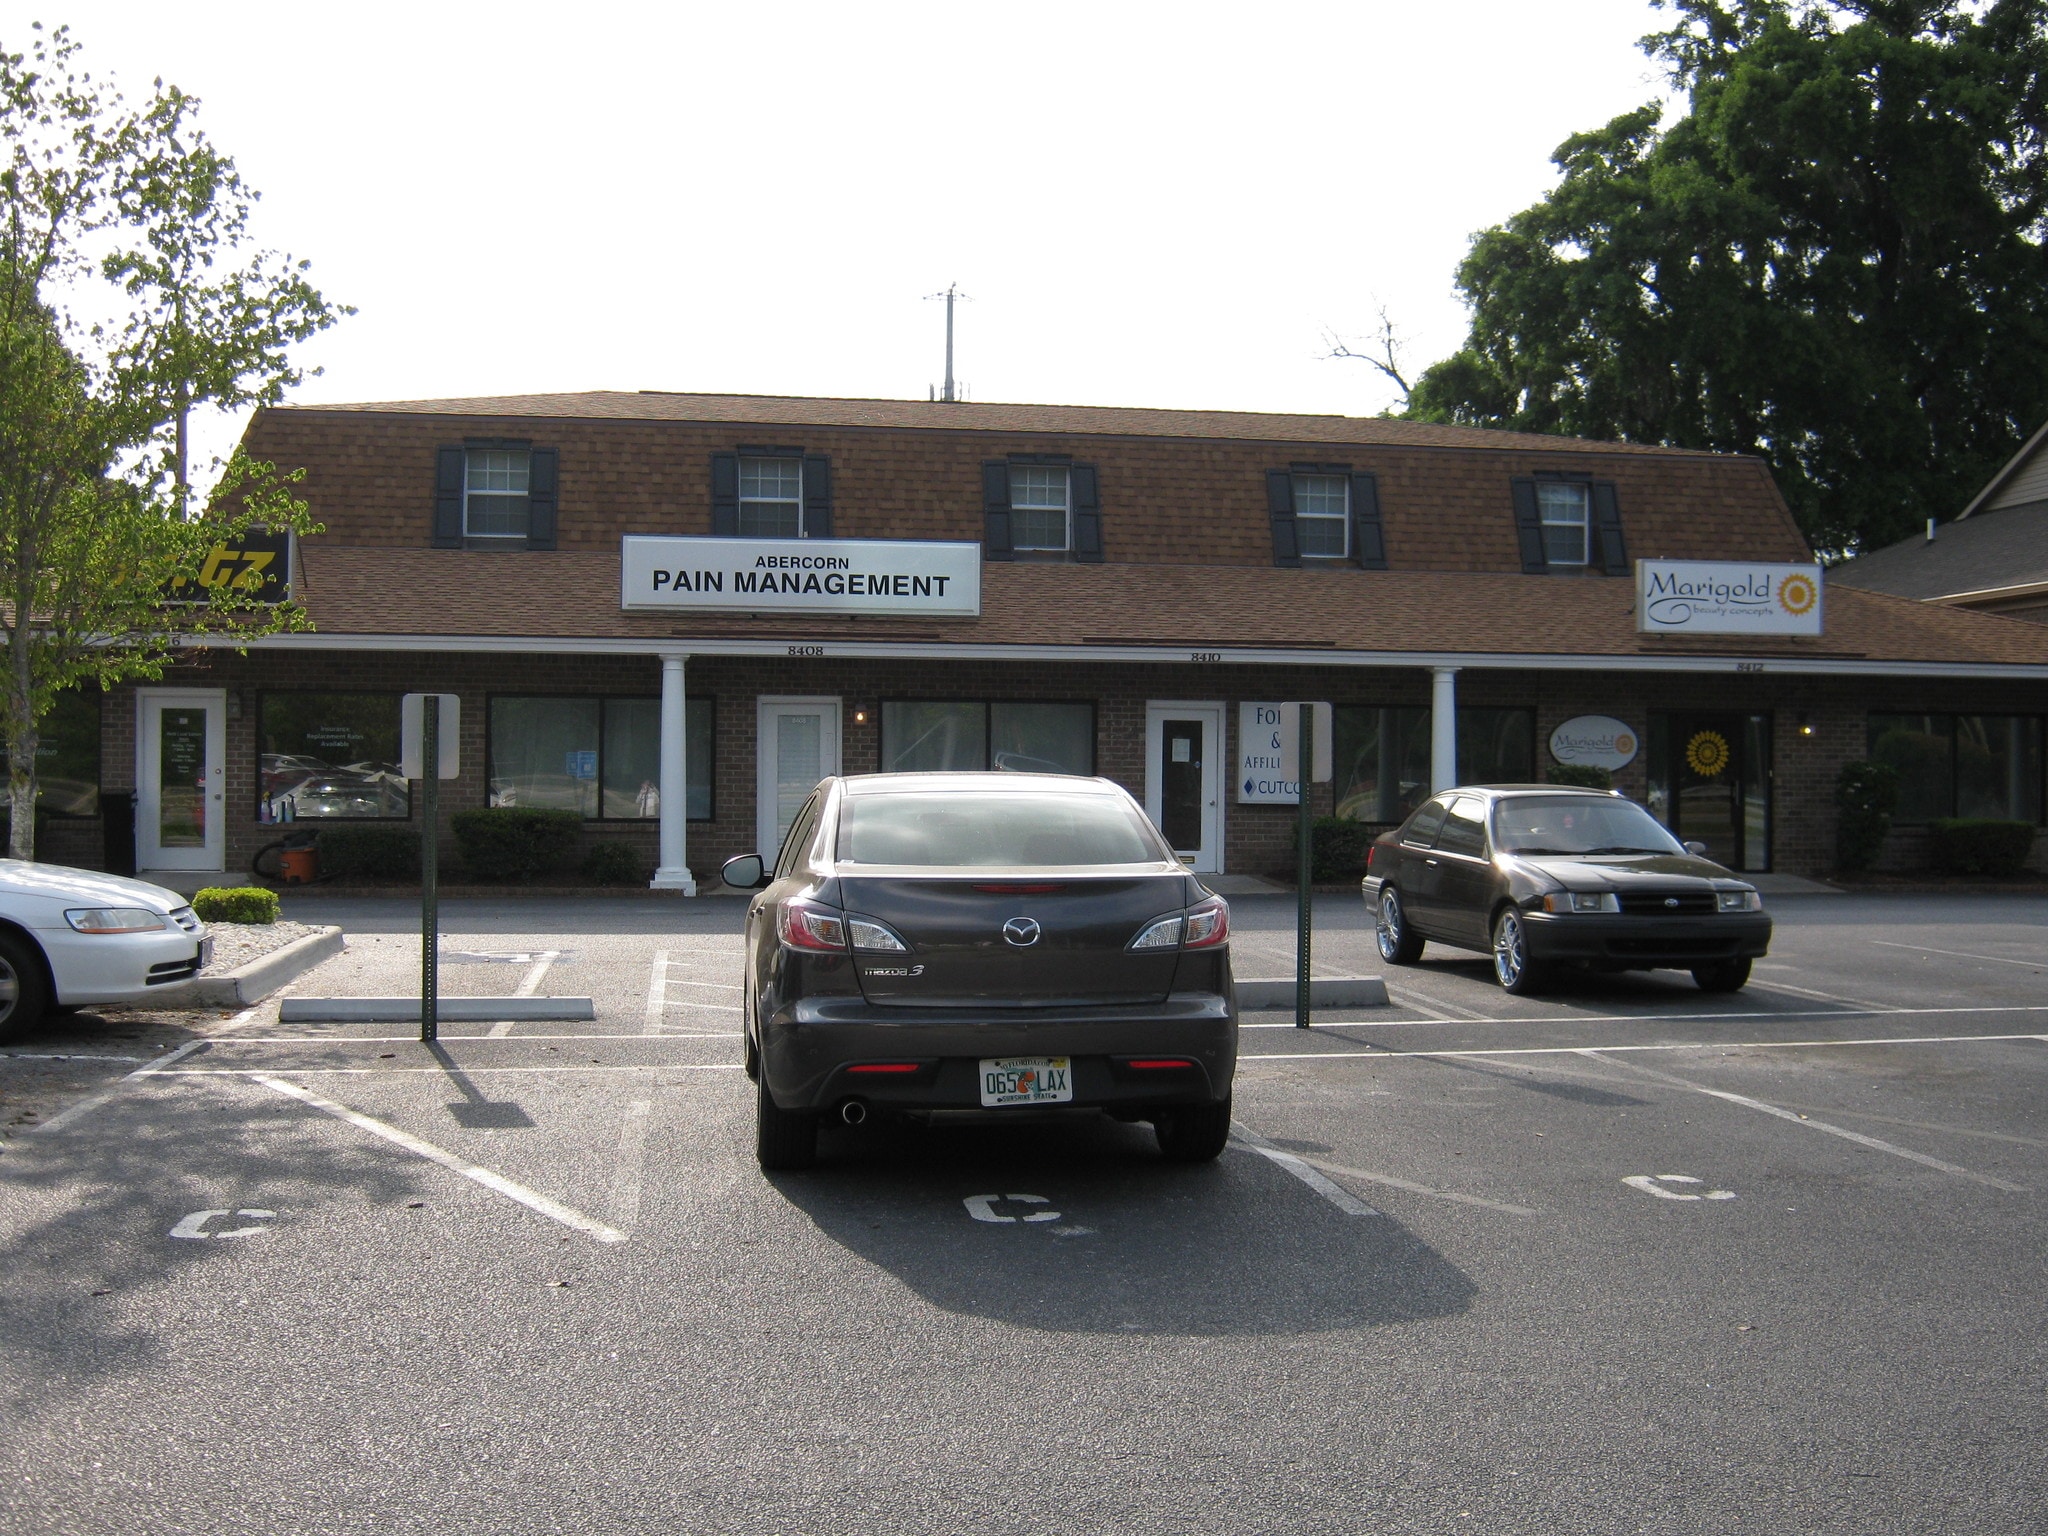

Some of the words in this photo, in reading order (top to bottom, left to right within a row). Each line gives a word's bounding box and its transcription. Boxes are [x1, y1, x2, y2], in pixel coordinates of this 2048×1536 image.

[755, 556, 850, 570] ABERCORN
[652, 570, 724, 592] PAIN
[734, 571, 951, 597] MANAGEMENT
[1647, 572, 1771, 605] Marigold
[1693, 604, 1727, 617] beauty
[1729, 608, 1774, 618] concepts
[787, 646, 824, 657] 8408
[1191, 653, 1221, 662] 8410
[1736, 663, 1765, 672] 8412
[1554, 734, 1615, 750] Marigold
[1244, 755, 1281, 769] AFFILI
[986, 1072, 1018, 1095] 065
[1035, 1069, 1067, 1092] LAX
[1002, 1094, 1031, 1102] SUNSHINE
[1034, 1092, 1052, 1100] STATE
